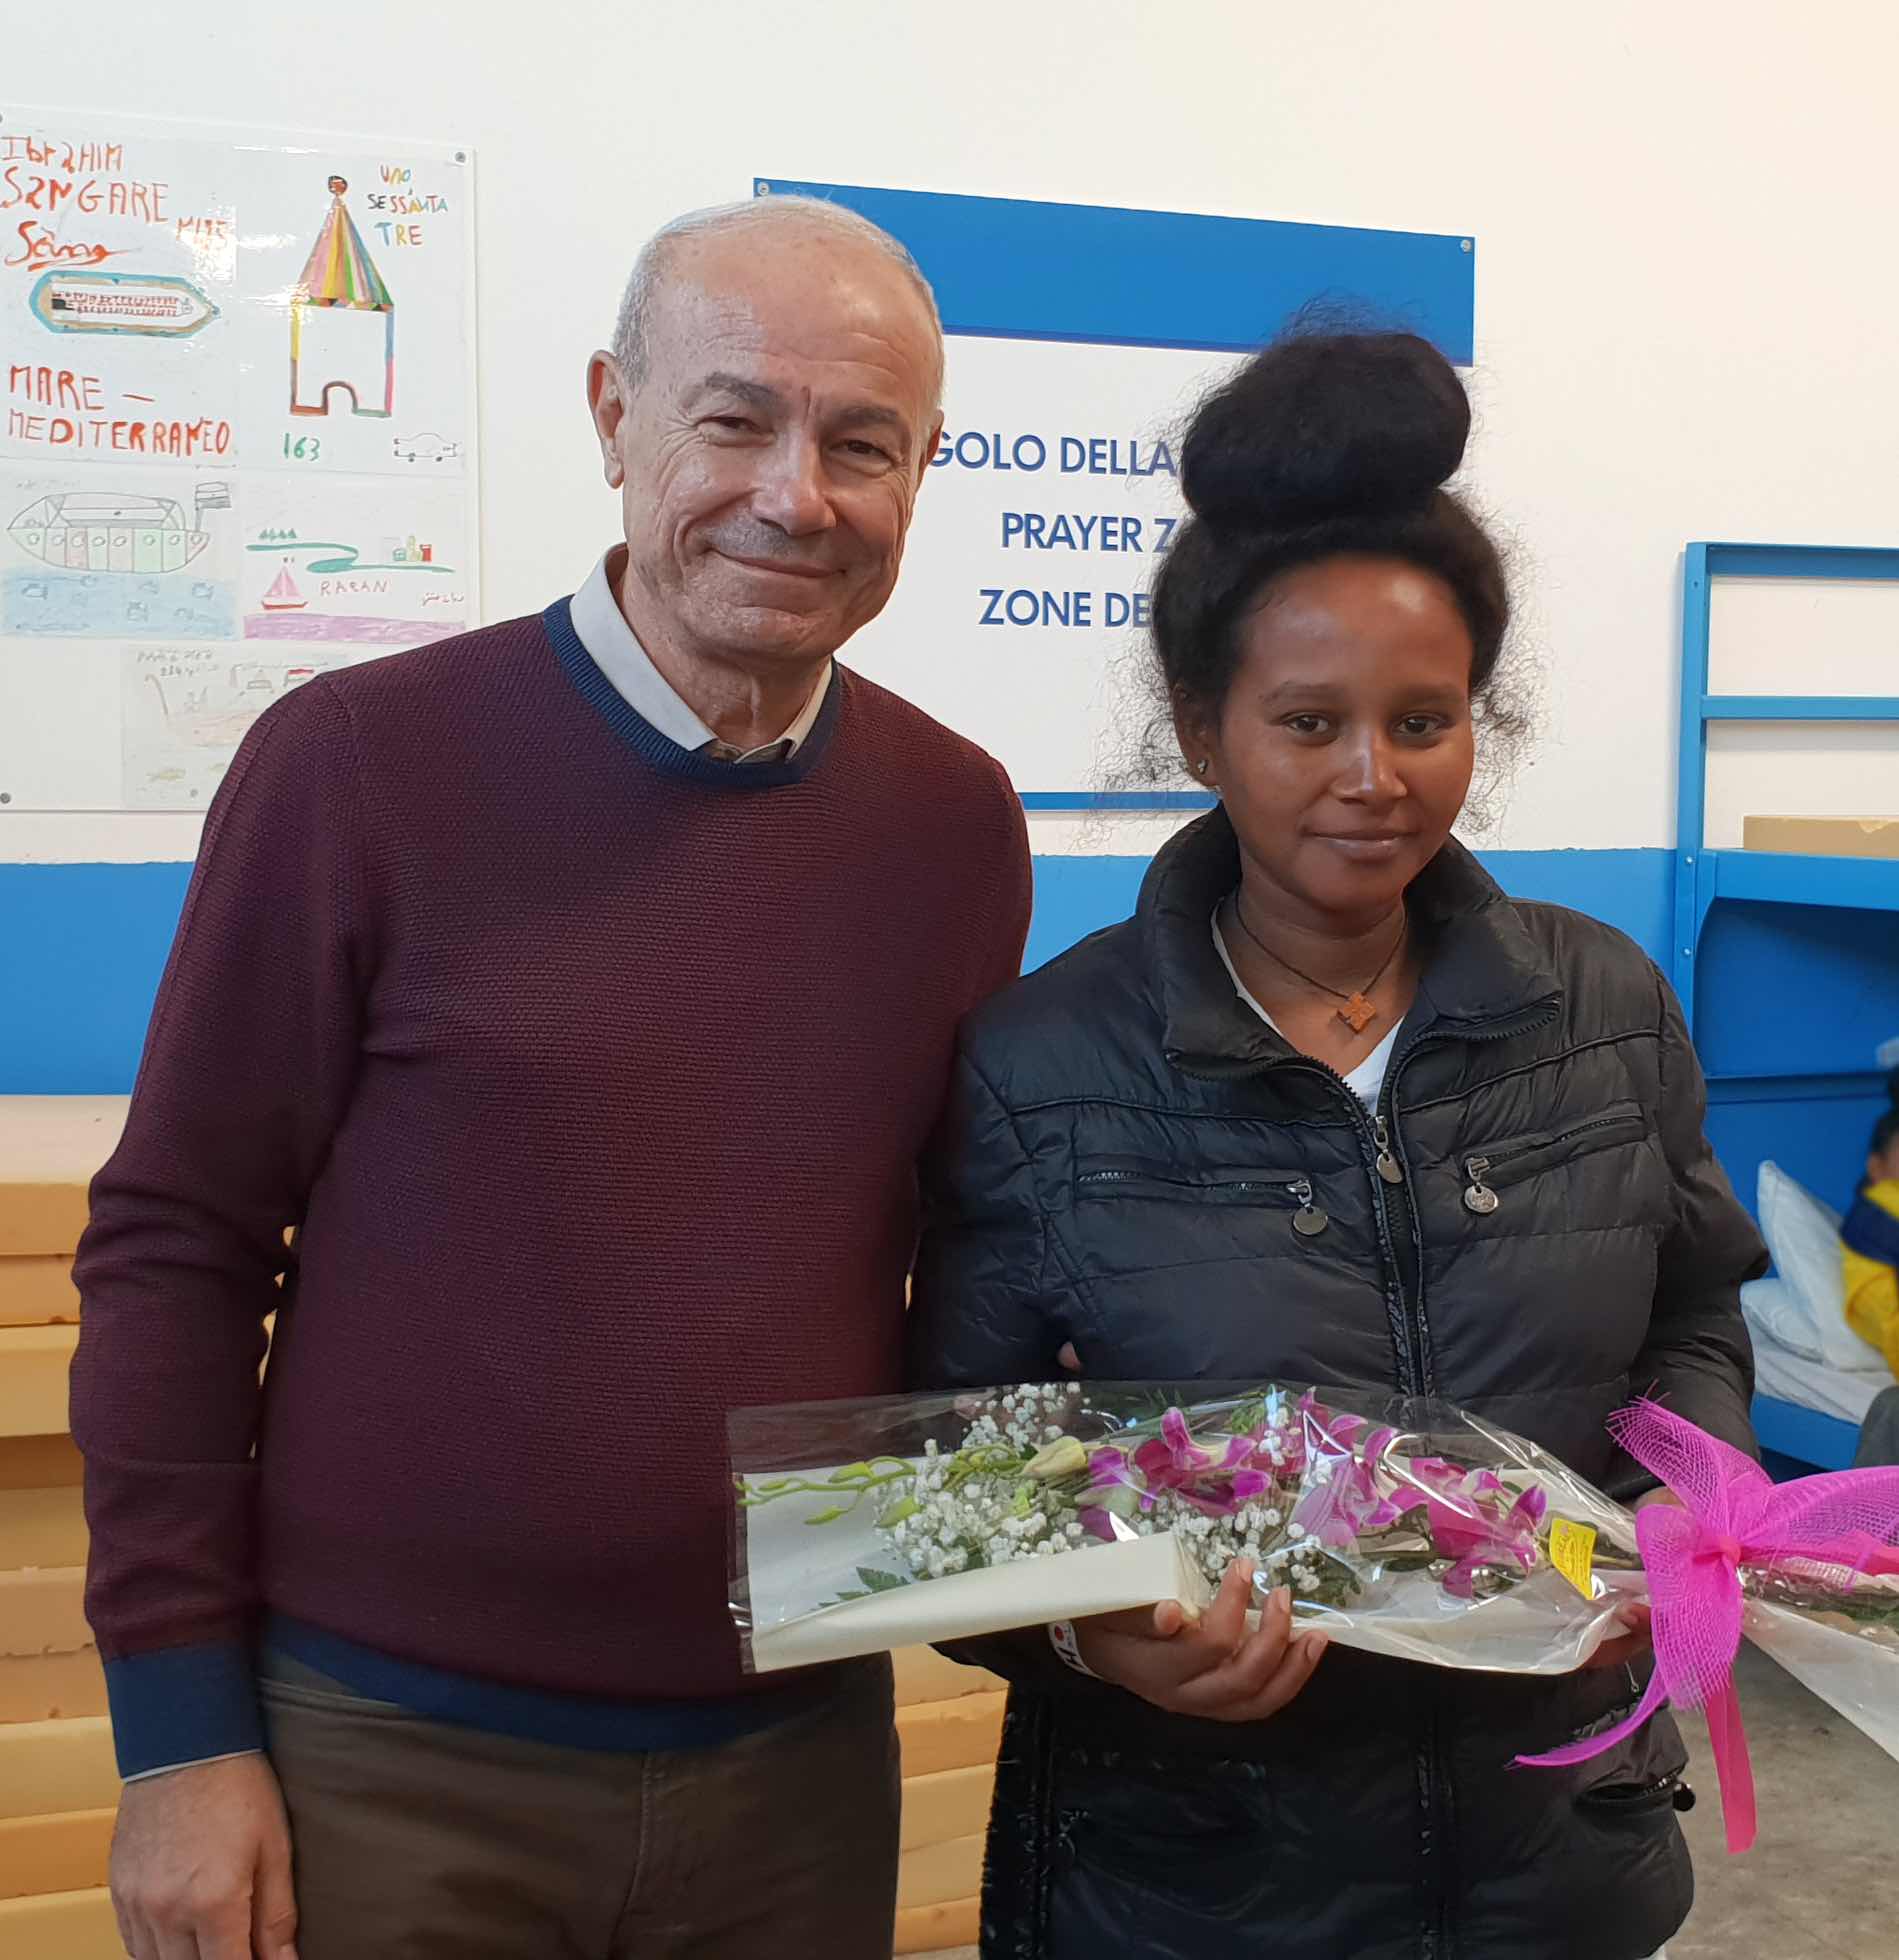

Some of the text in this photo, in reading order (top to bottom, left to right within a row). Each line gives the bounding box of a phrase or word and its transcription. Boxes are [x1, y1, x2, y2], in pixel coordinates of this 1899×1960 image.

[374, 221, 423, 246] TRE
[10, 365, 104, 411] MARE
[284, 432, 321, 462] 163
[1060, 437, 1177, 477] DELLA
[1002, 512, 1143, 553] PRAYER
[979, 590, 1091, 627] ZONE
